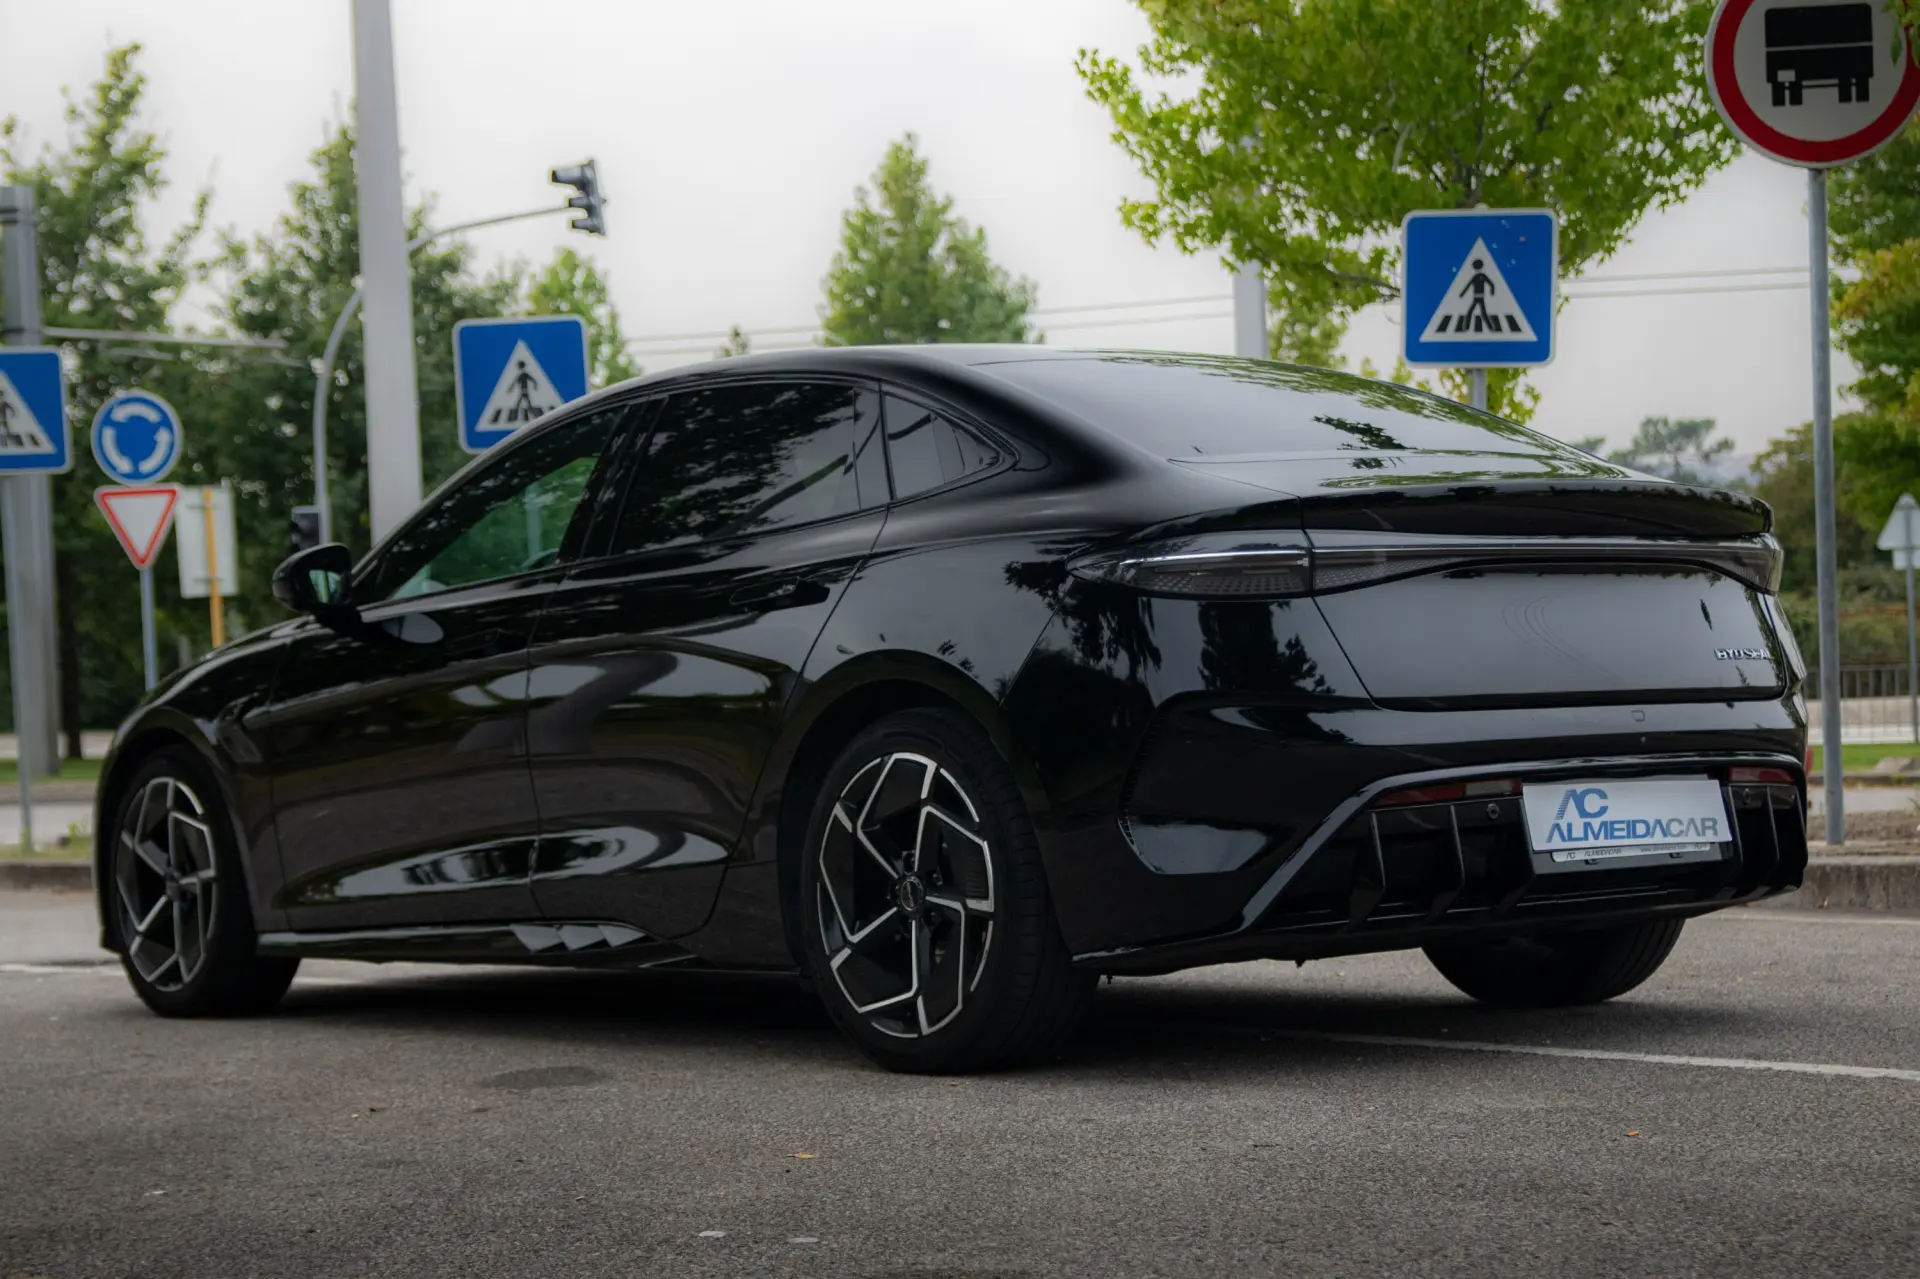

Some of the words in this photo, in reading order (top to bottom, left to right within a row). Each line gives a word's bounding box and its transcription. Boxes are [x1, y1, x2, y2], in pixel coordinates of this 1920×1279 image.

[1714, 648, 1743, 660] BYD
[1554, 787, 1609, 820] AC
[1545, 817, 1719, 843] ALMEIDACAR
